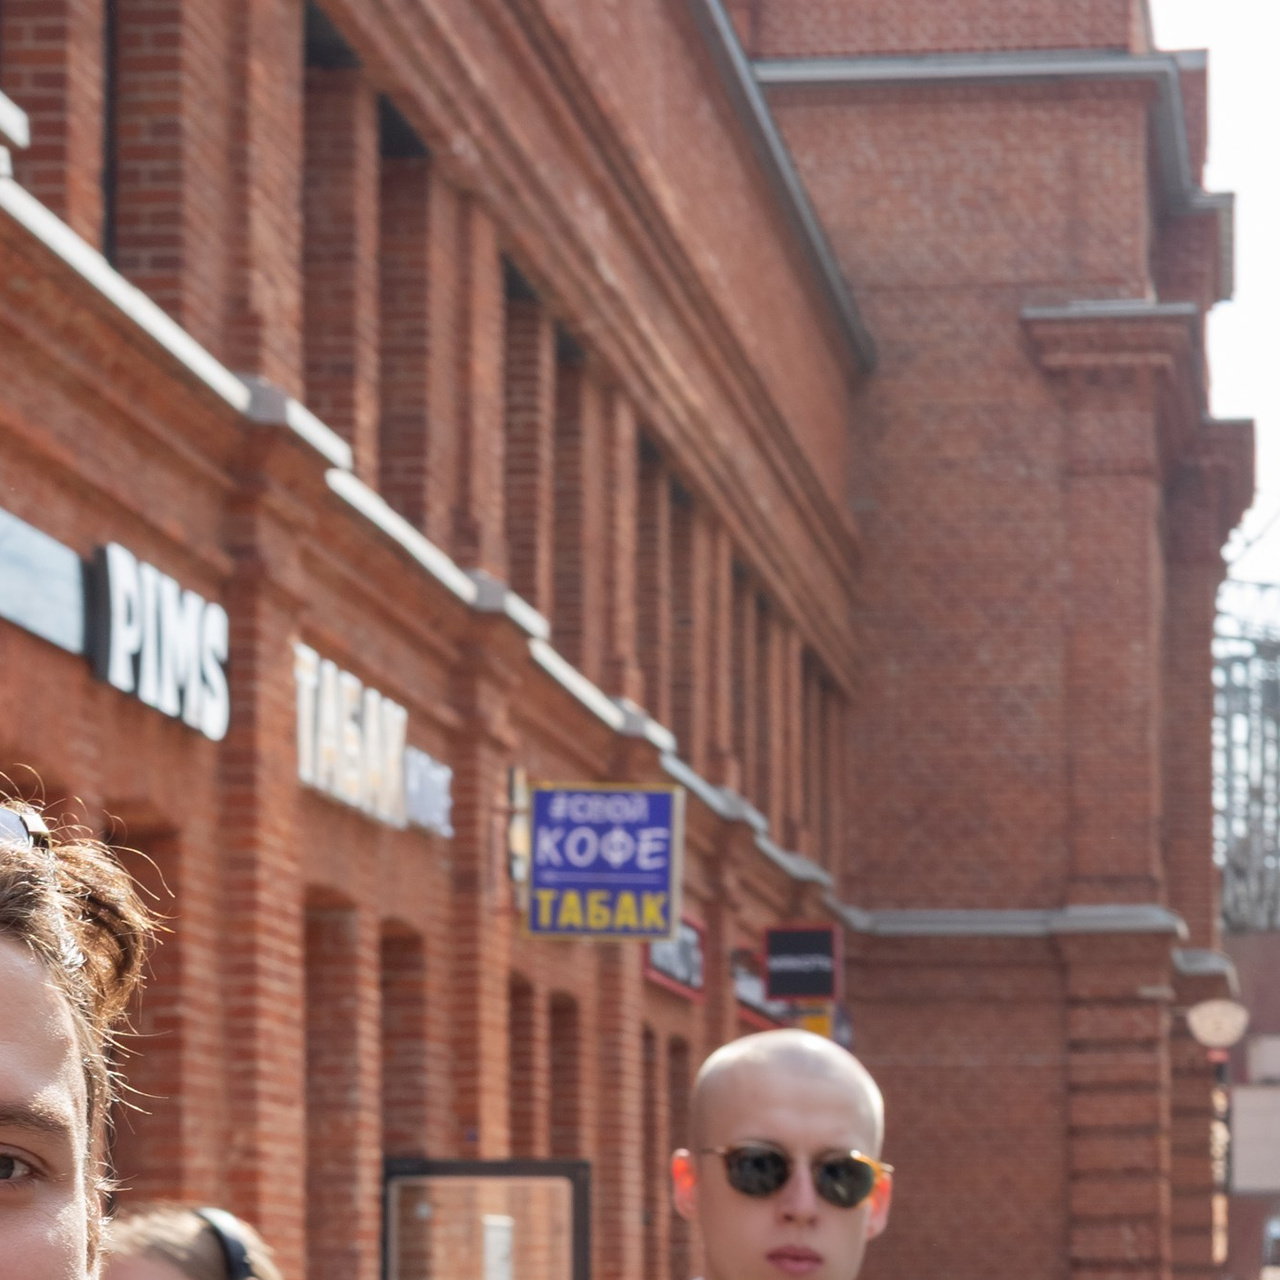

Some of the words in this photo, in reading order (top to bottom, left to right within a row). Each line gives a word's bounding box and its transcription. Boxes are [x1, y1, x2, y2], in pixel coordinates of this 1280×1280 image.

[107, 541, 230, 741] PIMS
[535, 826, 669, 870] КОФЕ
[535, 889, 666, 930] ТАБАК
